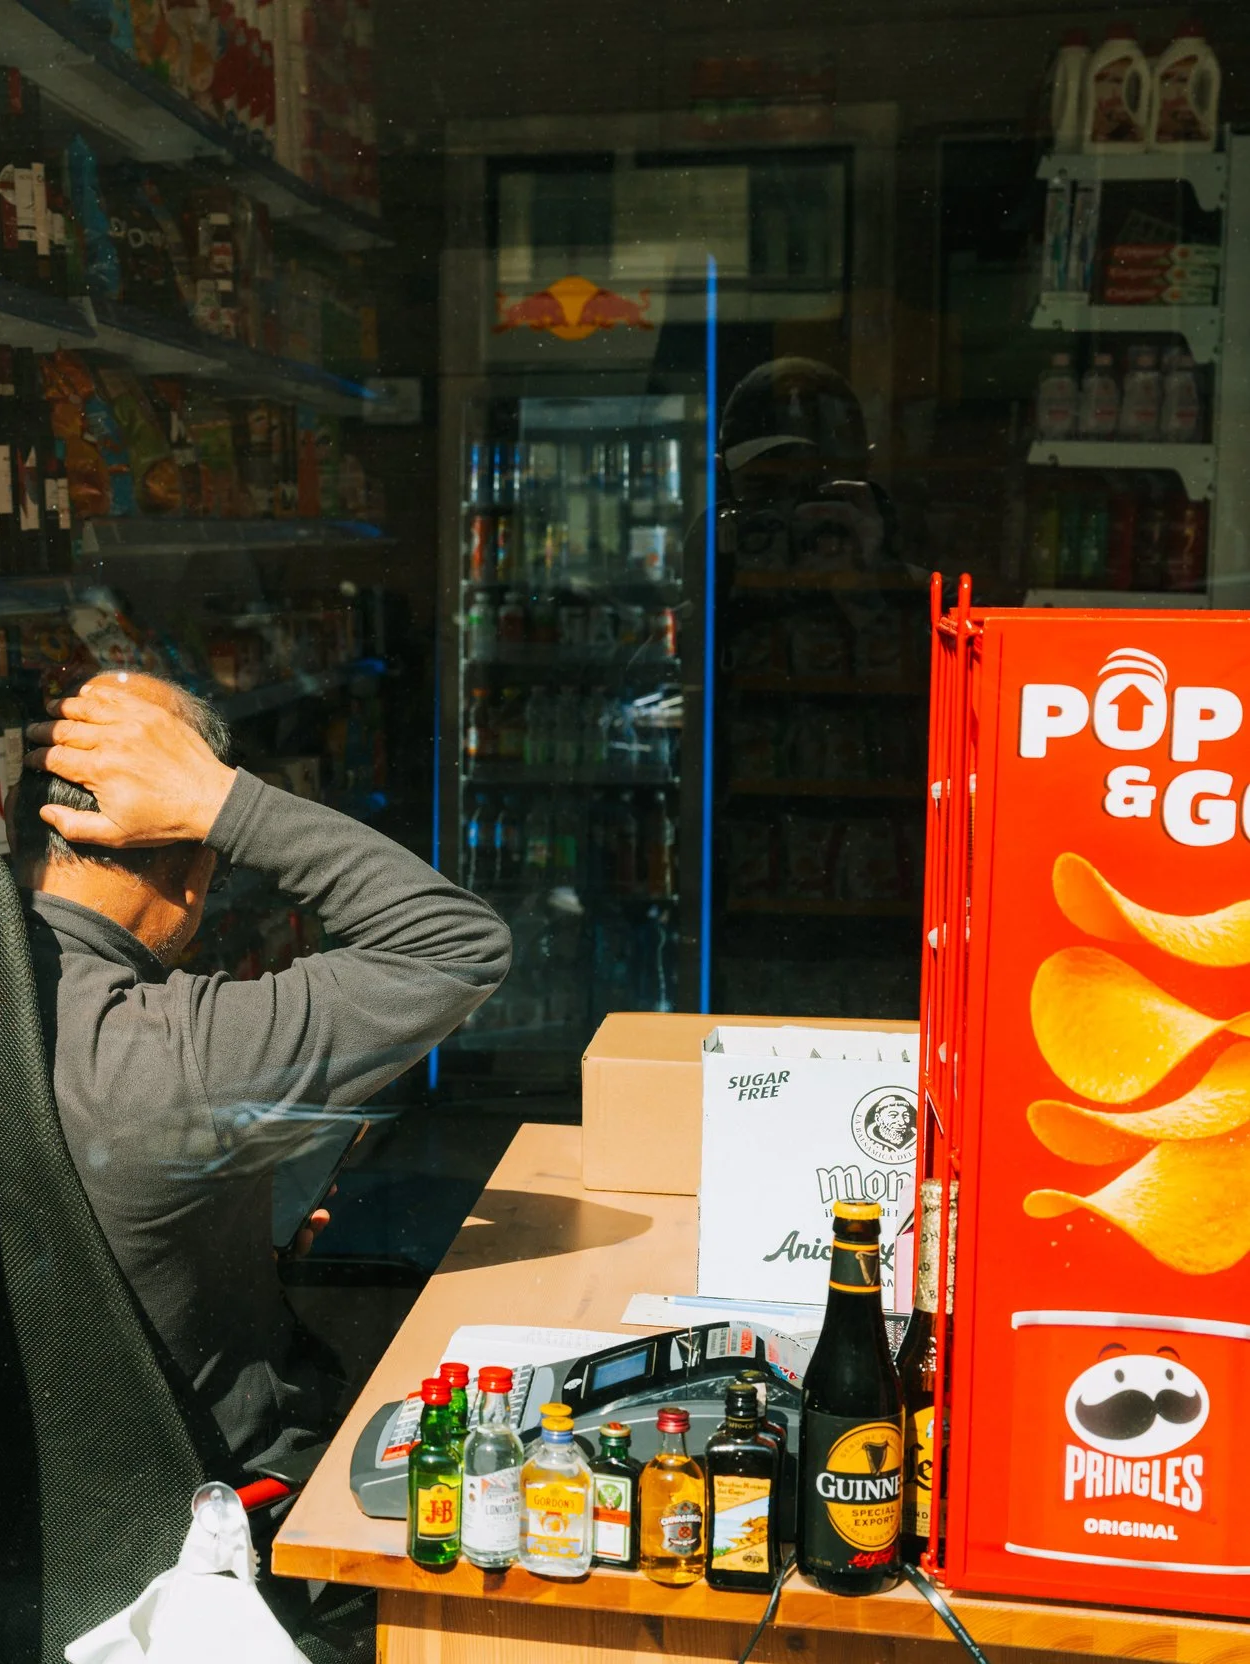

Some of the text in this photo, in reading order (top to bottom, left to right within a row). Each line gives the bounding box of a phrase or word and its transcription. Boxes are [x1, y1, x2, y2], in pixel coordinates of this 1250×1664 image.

[1019, 672, 1243, 763] POP
[728, 1070, 791, 1089] SUGAR
[738, 1085, 780, 1101] FREE
[1064, 1444, 1203, 1512] PRINGLES
[851, 1505, 896, 1517] SPECIAL
[854, 1514, 894, 1527] EXPORT
[1083, 1517, 1179, 1541] ORIGINAL
